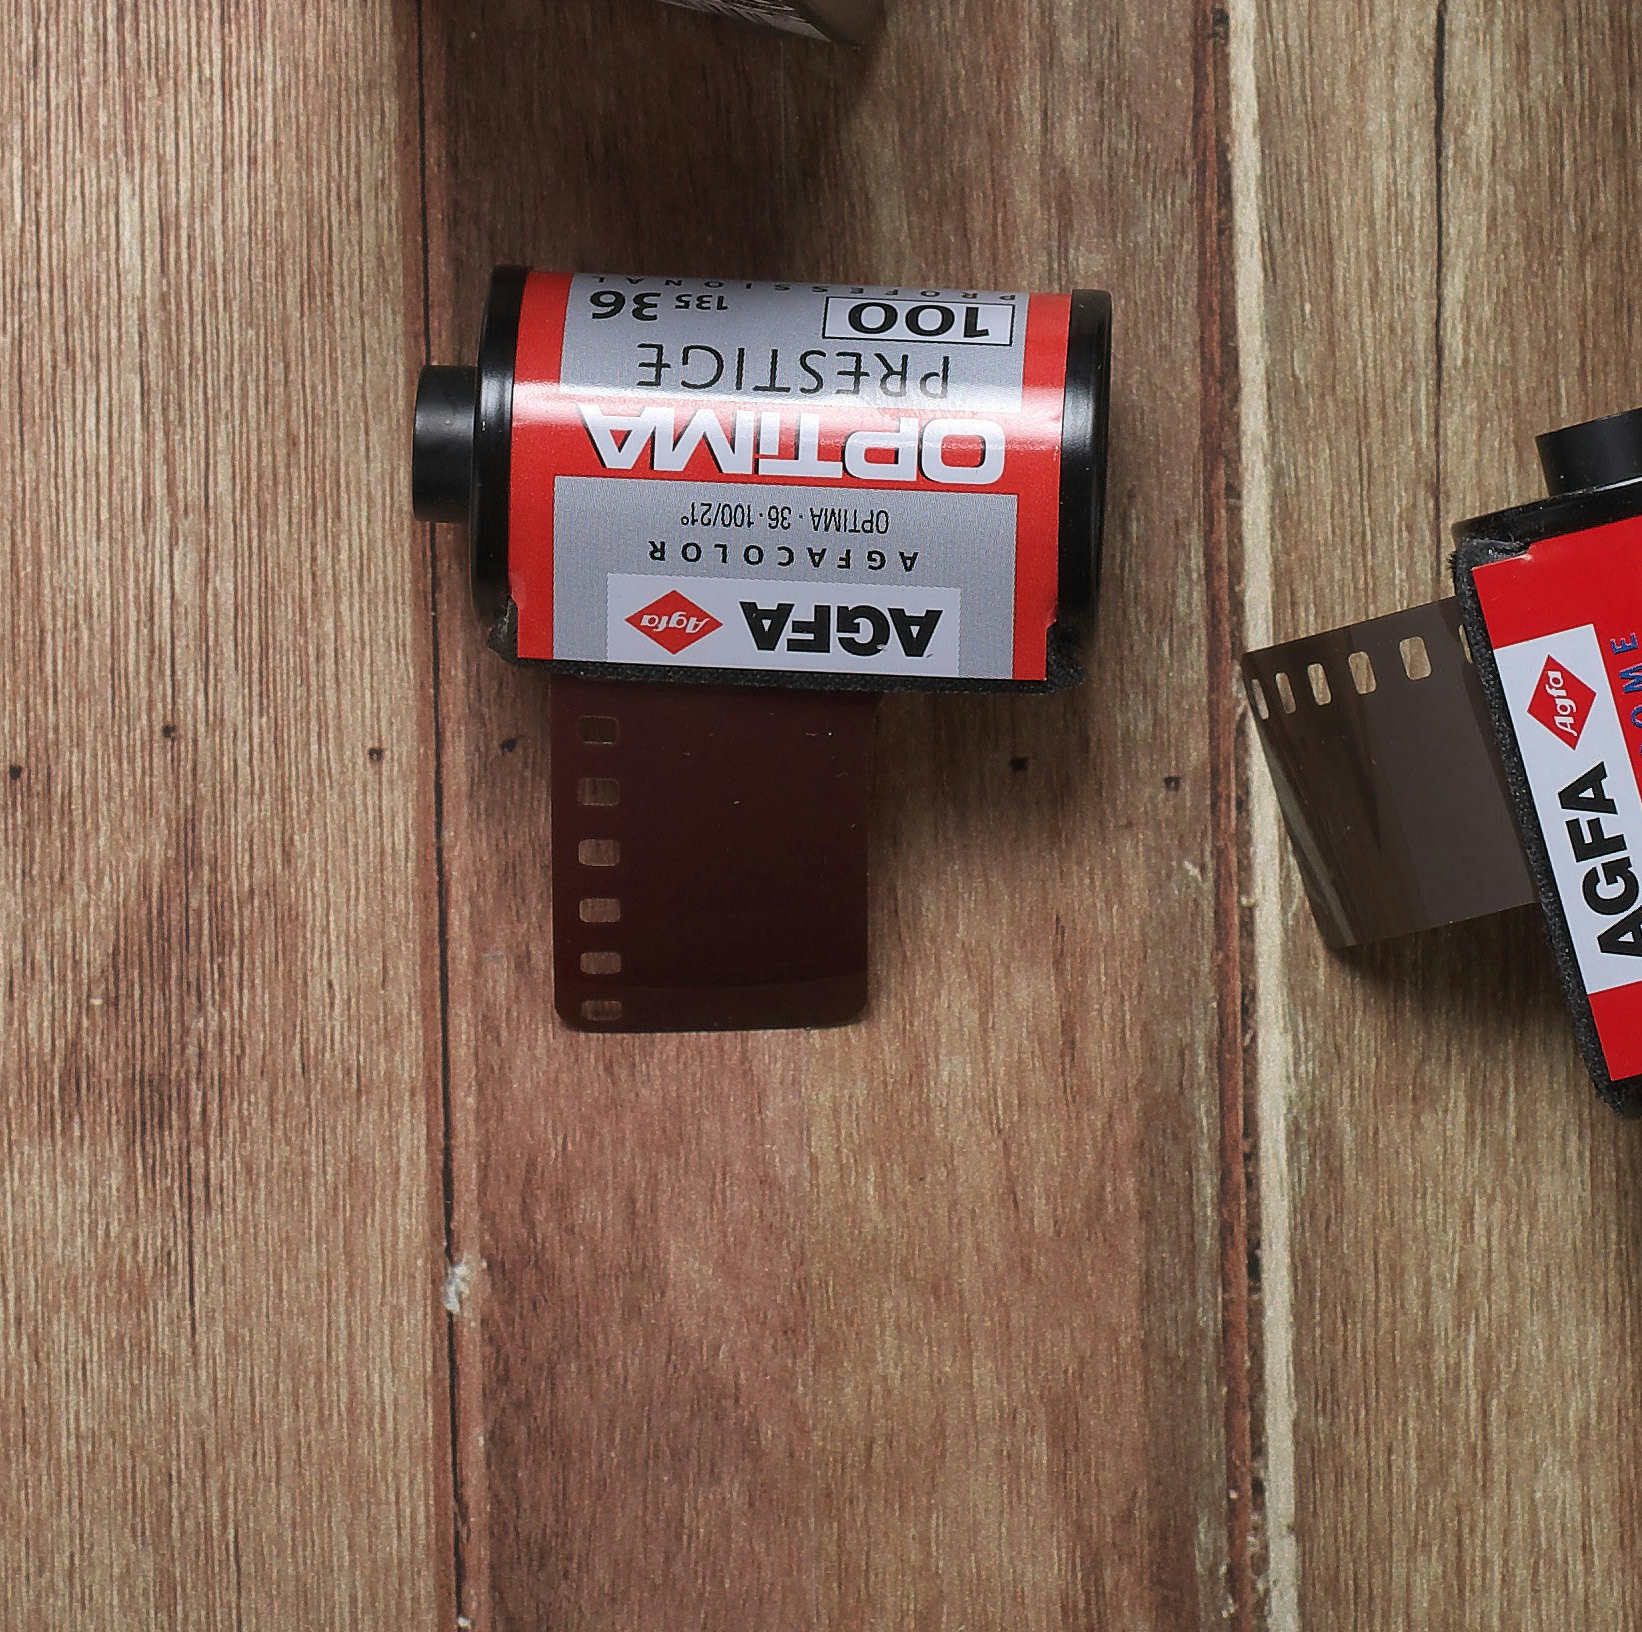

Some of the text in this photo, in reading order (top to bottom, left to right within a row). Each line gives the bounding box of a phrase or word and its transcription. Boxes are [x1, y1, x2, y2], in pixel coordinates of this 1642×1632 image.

[590, 290, 728, 321] 135 36
[591, 275, 1016, 301] PROFESSIONAL
[847, 302, 990, 339] 100
[636, 342, 949, 399] PRESTIGE
[577, 404, 1006, 485] OPTIMA
[809, 507, 890, 533] OPTIMA
[648, 540, 920, 571] AGFACOLOR
[639, 600, 942, 657] AGFA Agfa
[1545, 670, 1578, 737] Agfa
